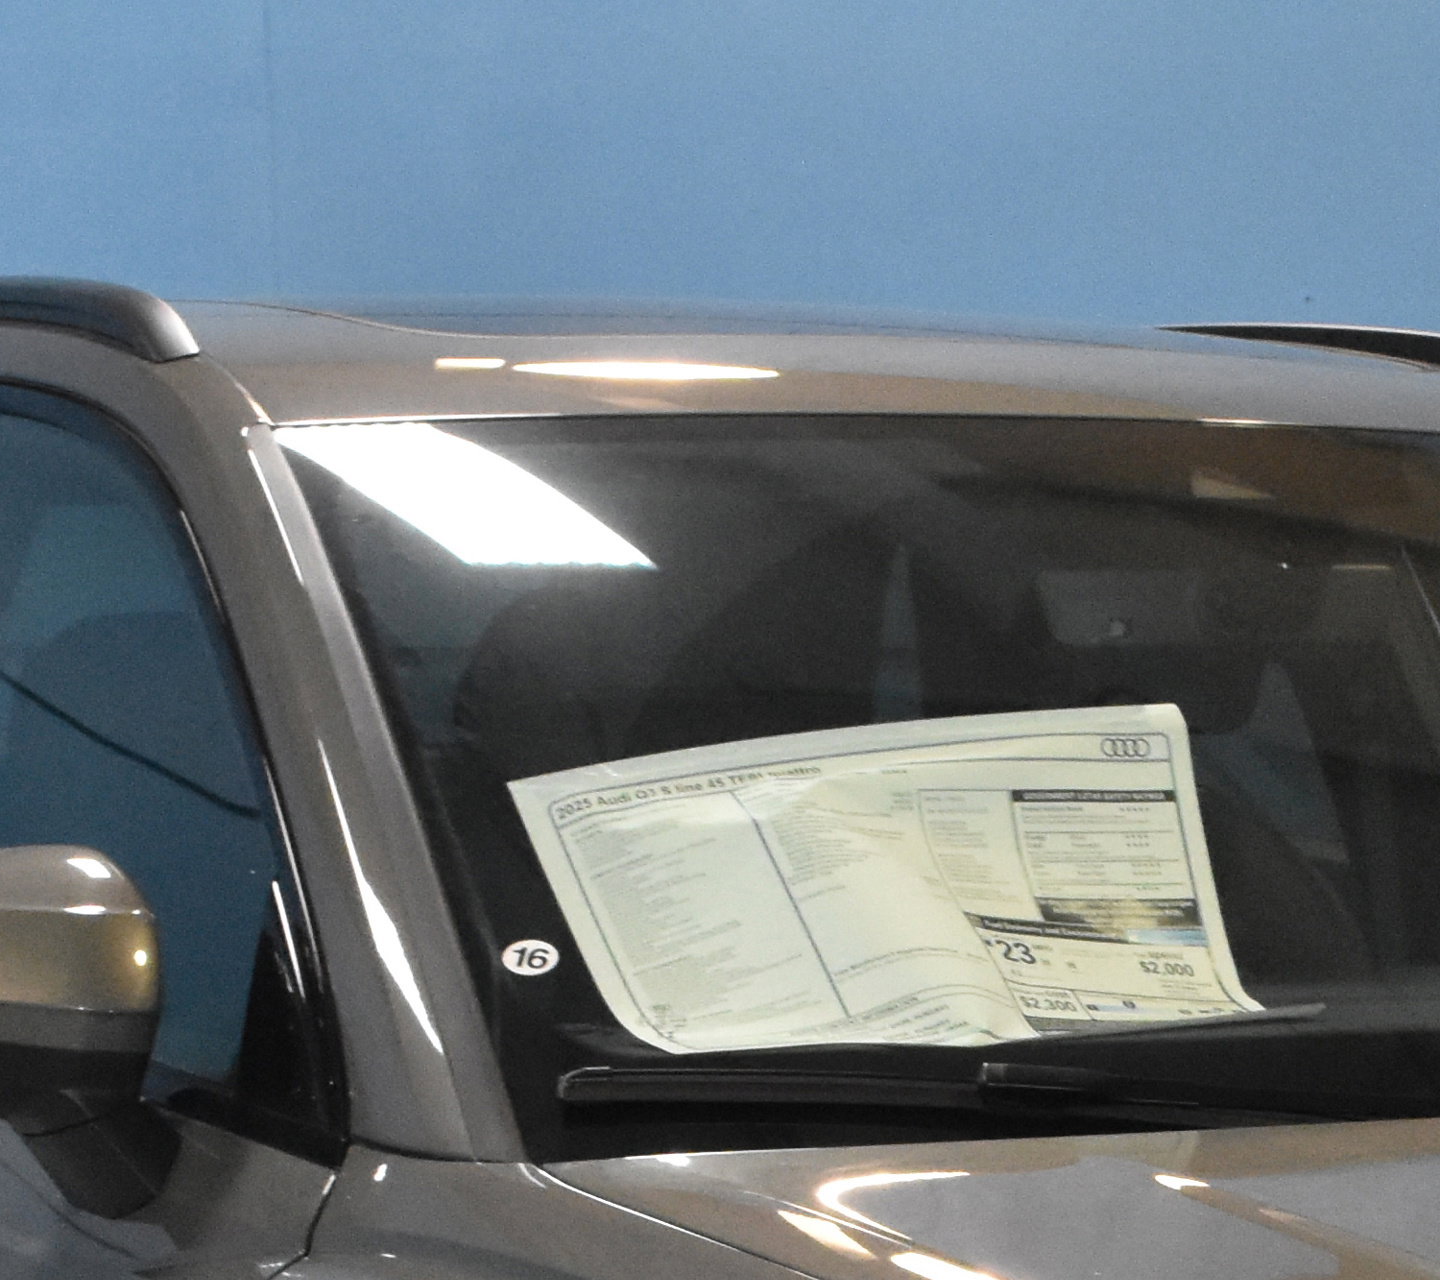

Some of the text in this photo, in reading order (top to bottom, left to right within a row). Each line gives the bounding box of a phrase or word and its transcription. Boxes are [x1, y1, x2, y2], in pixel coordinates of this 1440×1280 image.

[597, 793, 632, 806] Audi
[512, 946, 550, 970] 16
[994, 939, 1037, 965] 23
